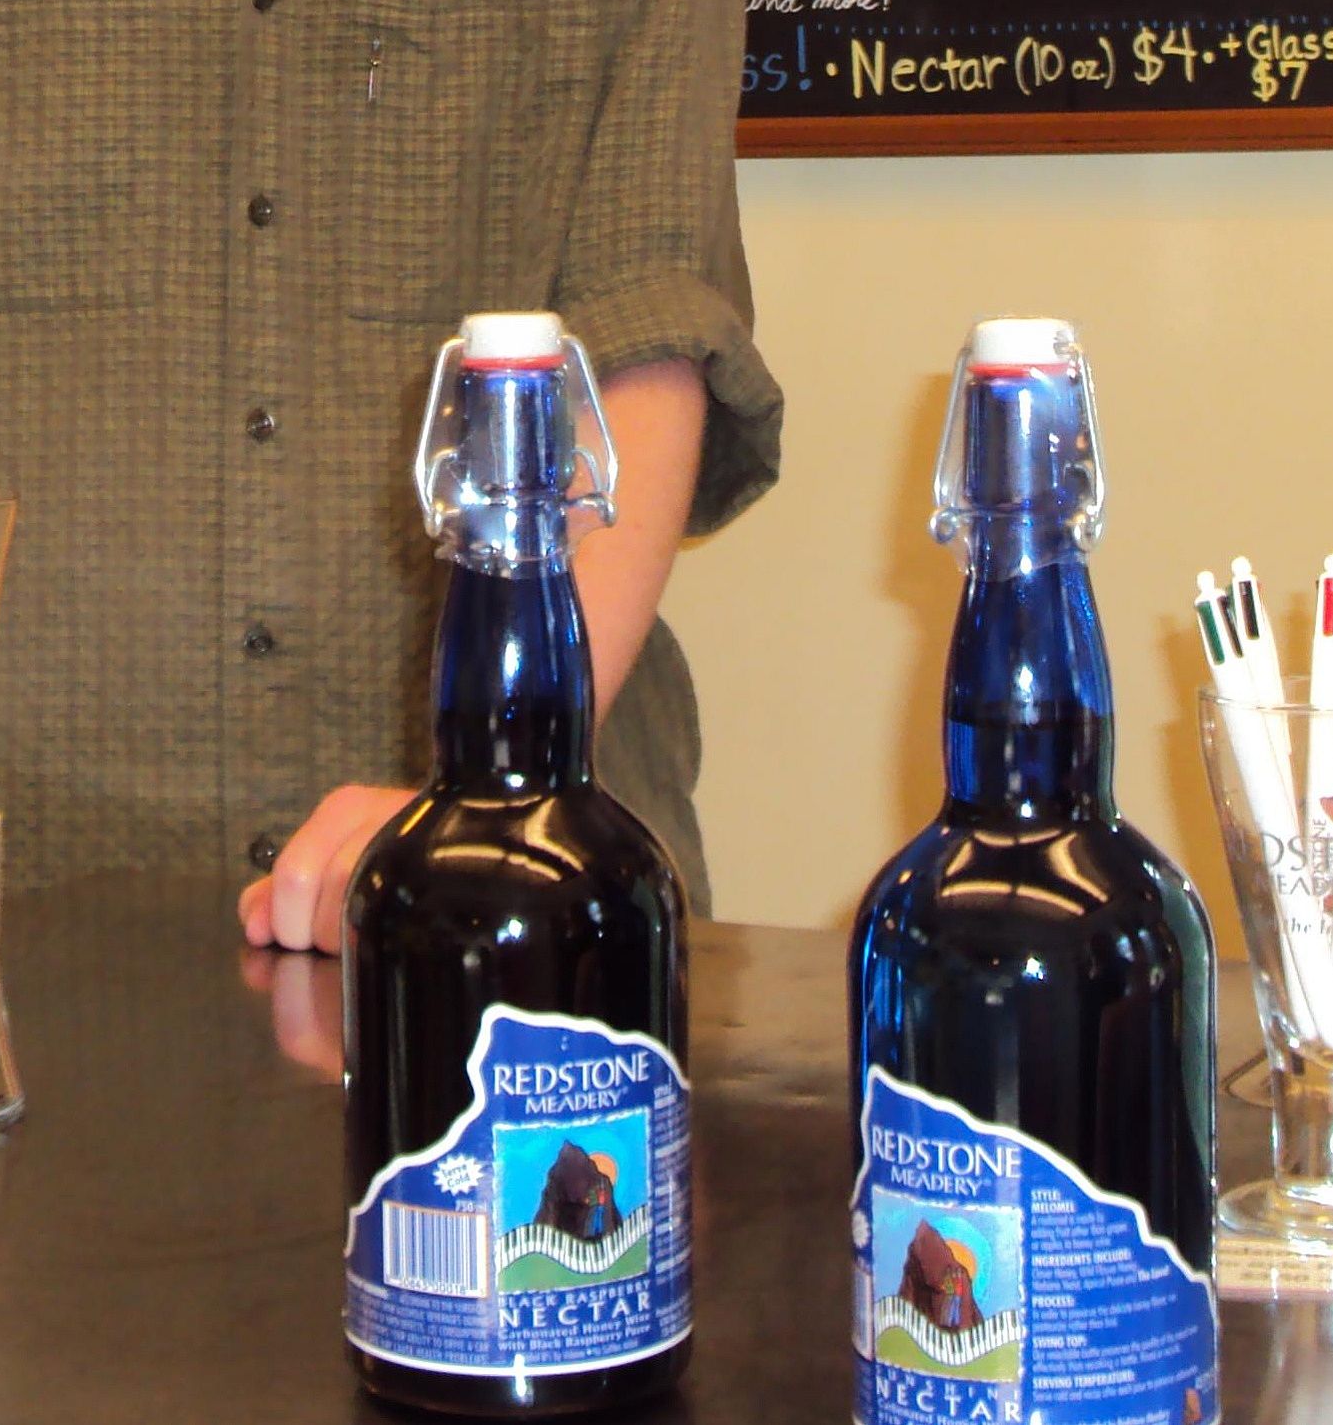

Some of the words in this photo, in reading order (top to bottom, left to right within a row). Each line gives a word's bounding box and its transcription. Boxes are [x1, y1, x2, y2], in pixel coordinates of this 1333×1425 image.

[850, 38, 1008, 100] Nectar
[492, 1051, 651, 1097] REDSTONE
[524, 1089, 621, 1116] MEADERY
[871, 1125, 1022, 1179] REDSTONE
[890, 1165, 983, 1198] MEADERY
[498, 1292, 556, 1308] BLACK
[565, 1278, 651, 1304] RASPBERRY
[498, 1290, 651, 1328] NECTAR
[876, 1375, 1021, 1422] NECTAR
